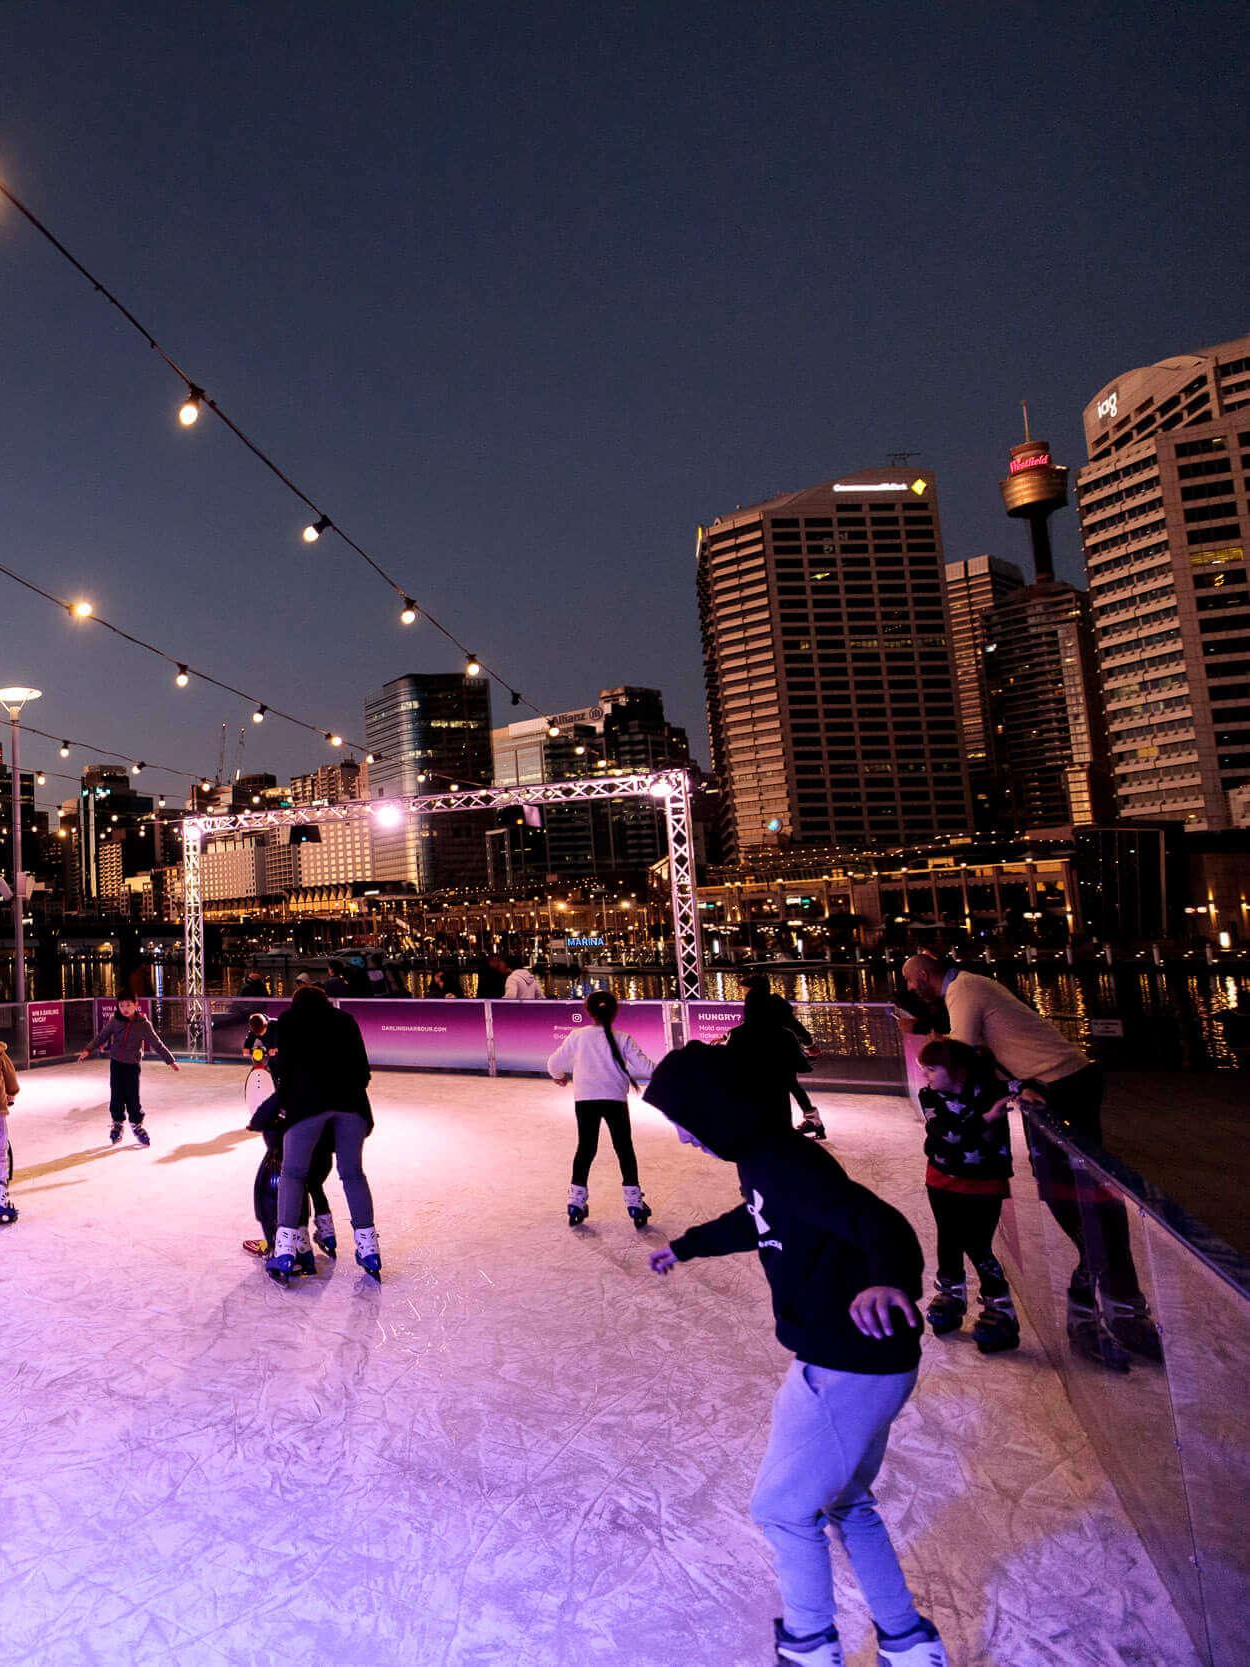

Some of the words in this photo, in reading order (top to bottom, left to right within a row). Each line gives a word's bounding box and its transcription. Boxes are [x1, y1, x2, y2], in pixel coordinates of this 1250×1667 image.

[1097, 392, 1117, 418] iag
[567, 937, 604, 946] MARINA
[698, 1013, 742, 1021] HUNGRY?
[381, 1025, 447, 1033] DARLINGHARBOUR.COM
